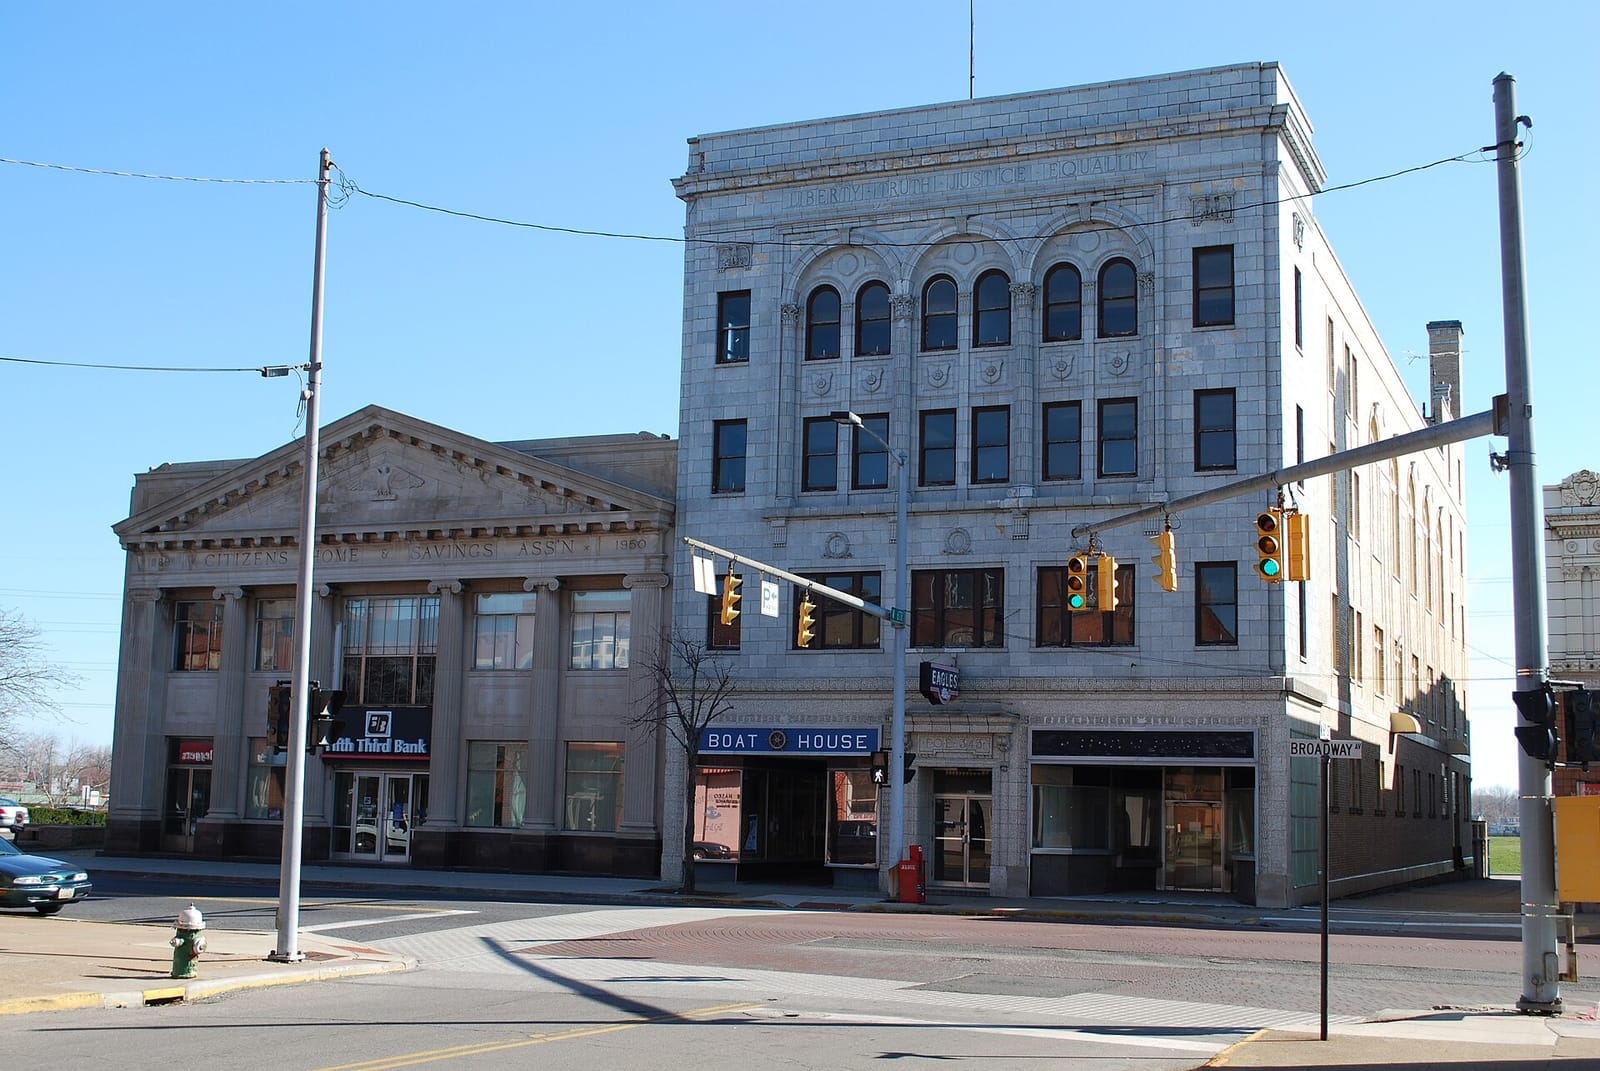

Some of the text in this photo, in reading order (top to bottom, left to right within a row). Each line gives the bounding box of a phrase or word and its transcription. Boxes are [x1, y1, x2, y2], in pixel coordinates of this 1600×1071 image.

[789, 152, 1149, 209] LIBERTY TRUTH JUSTICE EQUALITY
[204, 551, 288, 567] CITIZENS
[316, 548, 361, 563] OME
[381, 550, 389, 560] &
[410, 543, 494, 561] SAVINGS
[518, 539, 575, 557] ASS'N
[932, 670, 958, 690] EAGLES
[356, 738, 392, 753] Third
[394, 739, 427, 753] Bank
[708, 734, 868, 749] BOAT HOUSE
[1291, 742, 1353, 756] BROADWAY
